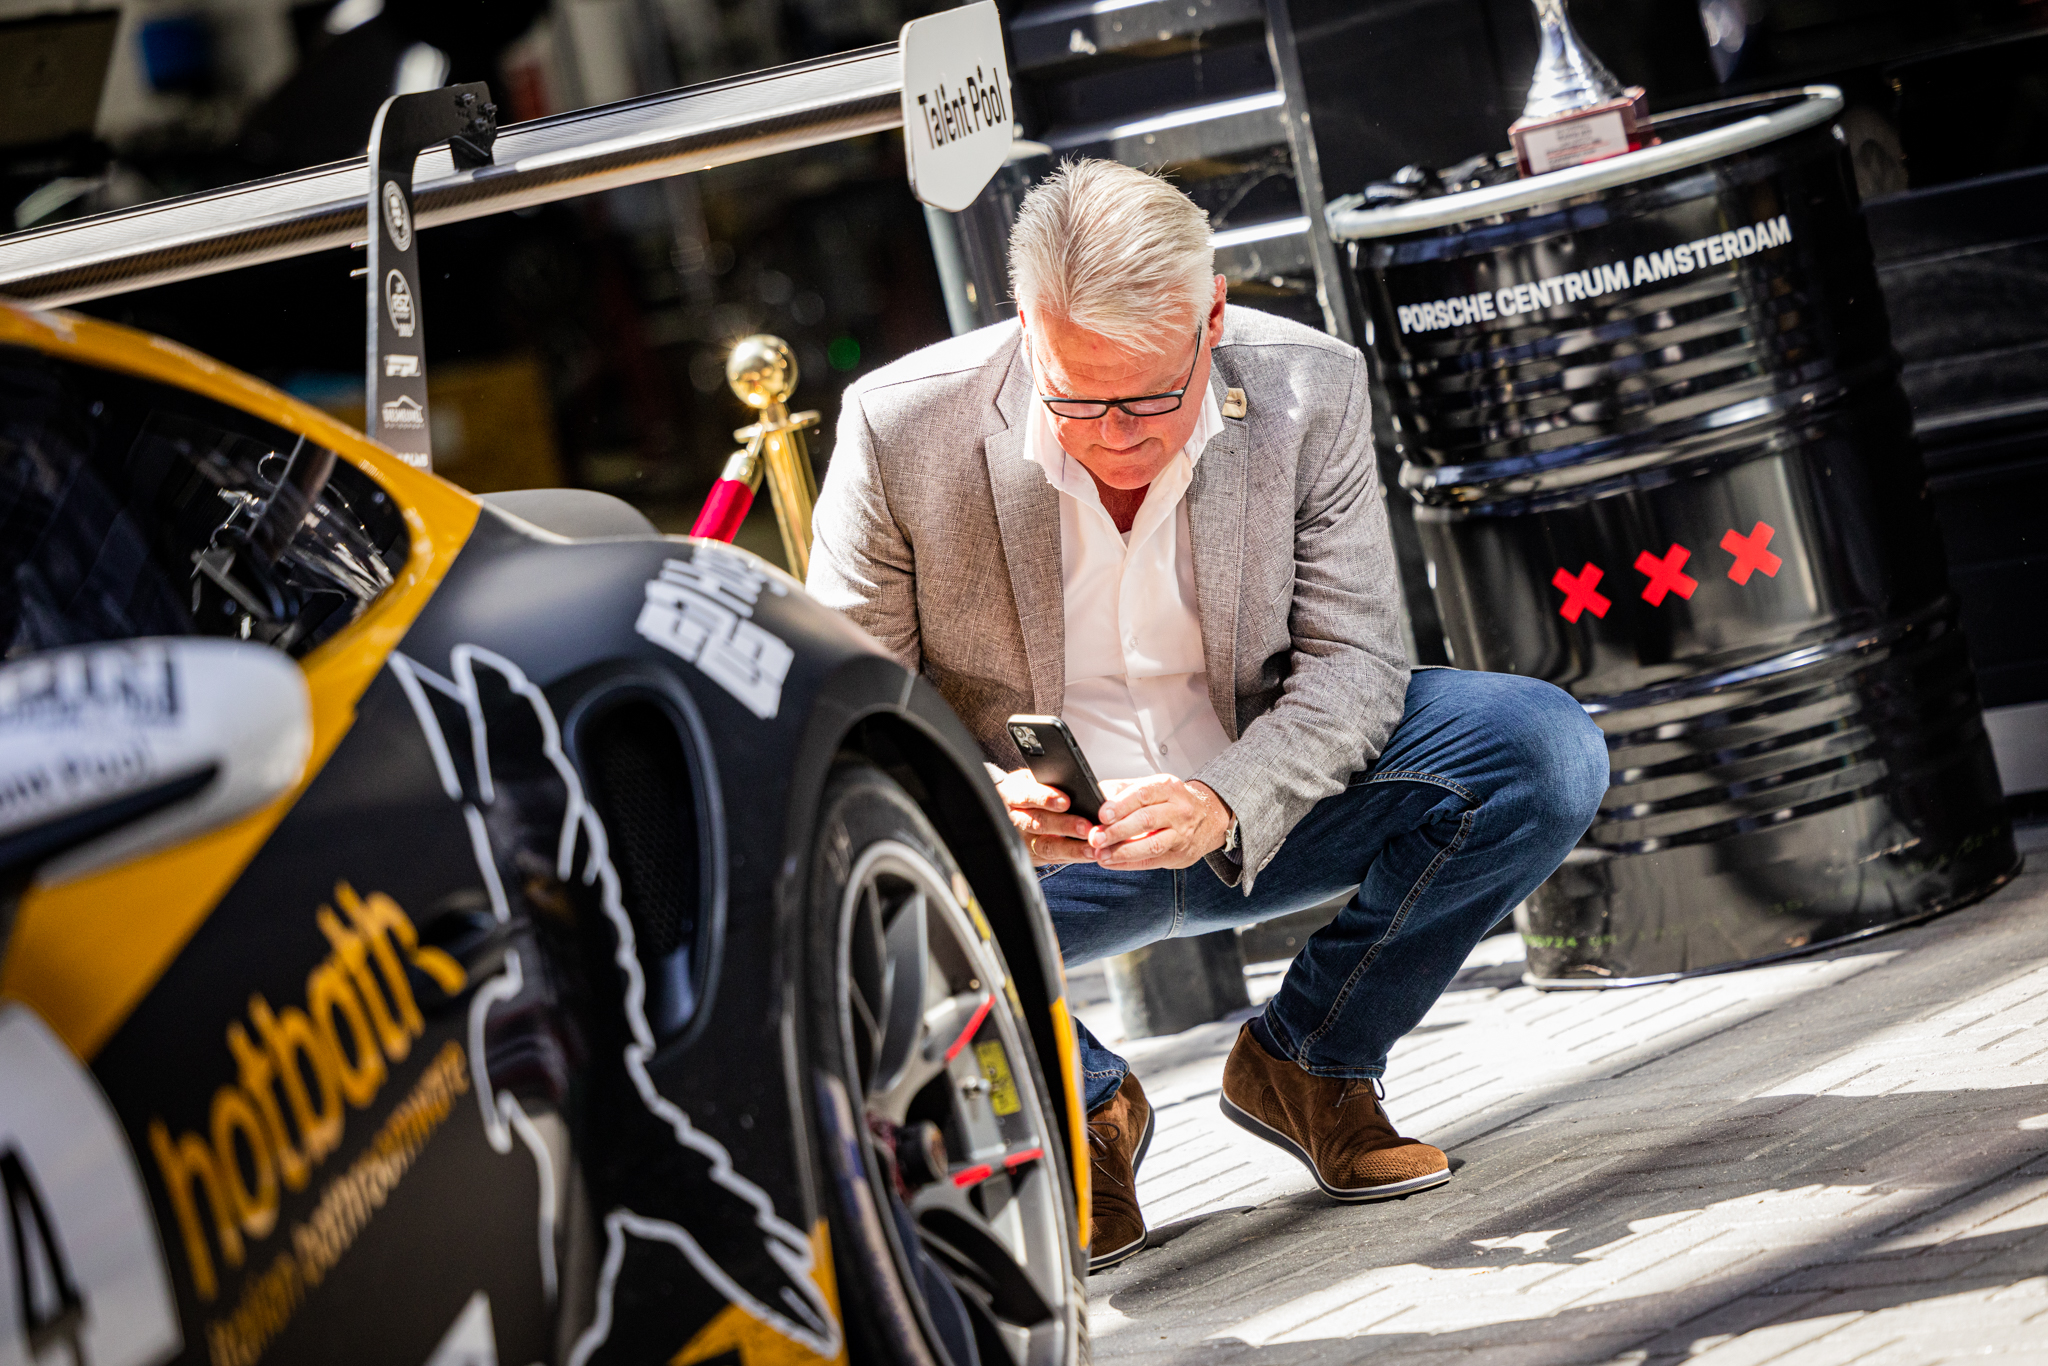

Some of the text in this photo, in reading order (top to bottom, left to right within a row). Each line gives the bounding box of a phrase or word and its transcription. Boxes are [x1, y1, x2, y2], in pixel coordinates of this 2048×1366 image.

[917, 67, 1007, 150] Talent Pool
[1397, 214, 1792, 334] PORSCHE CENTRUM AMSTERDAM
[148, 879, 468, 1300] hotbath
